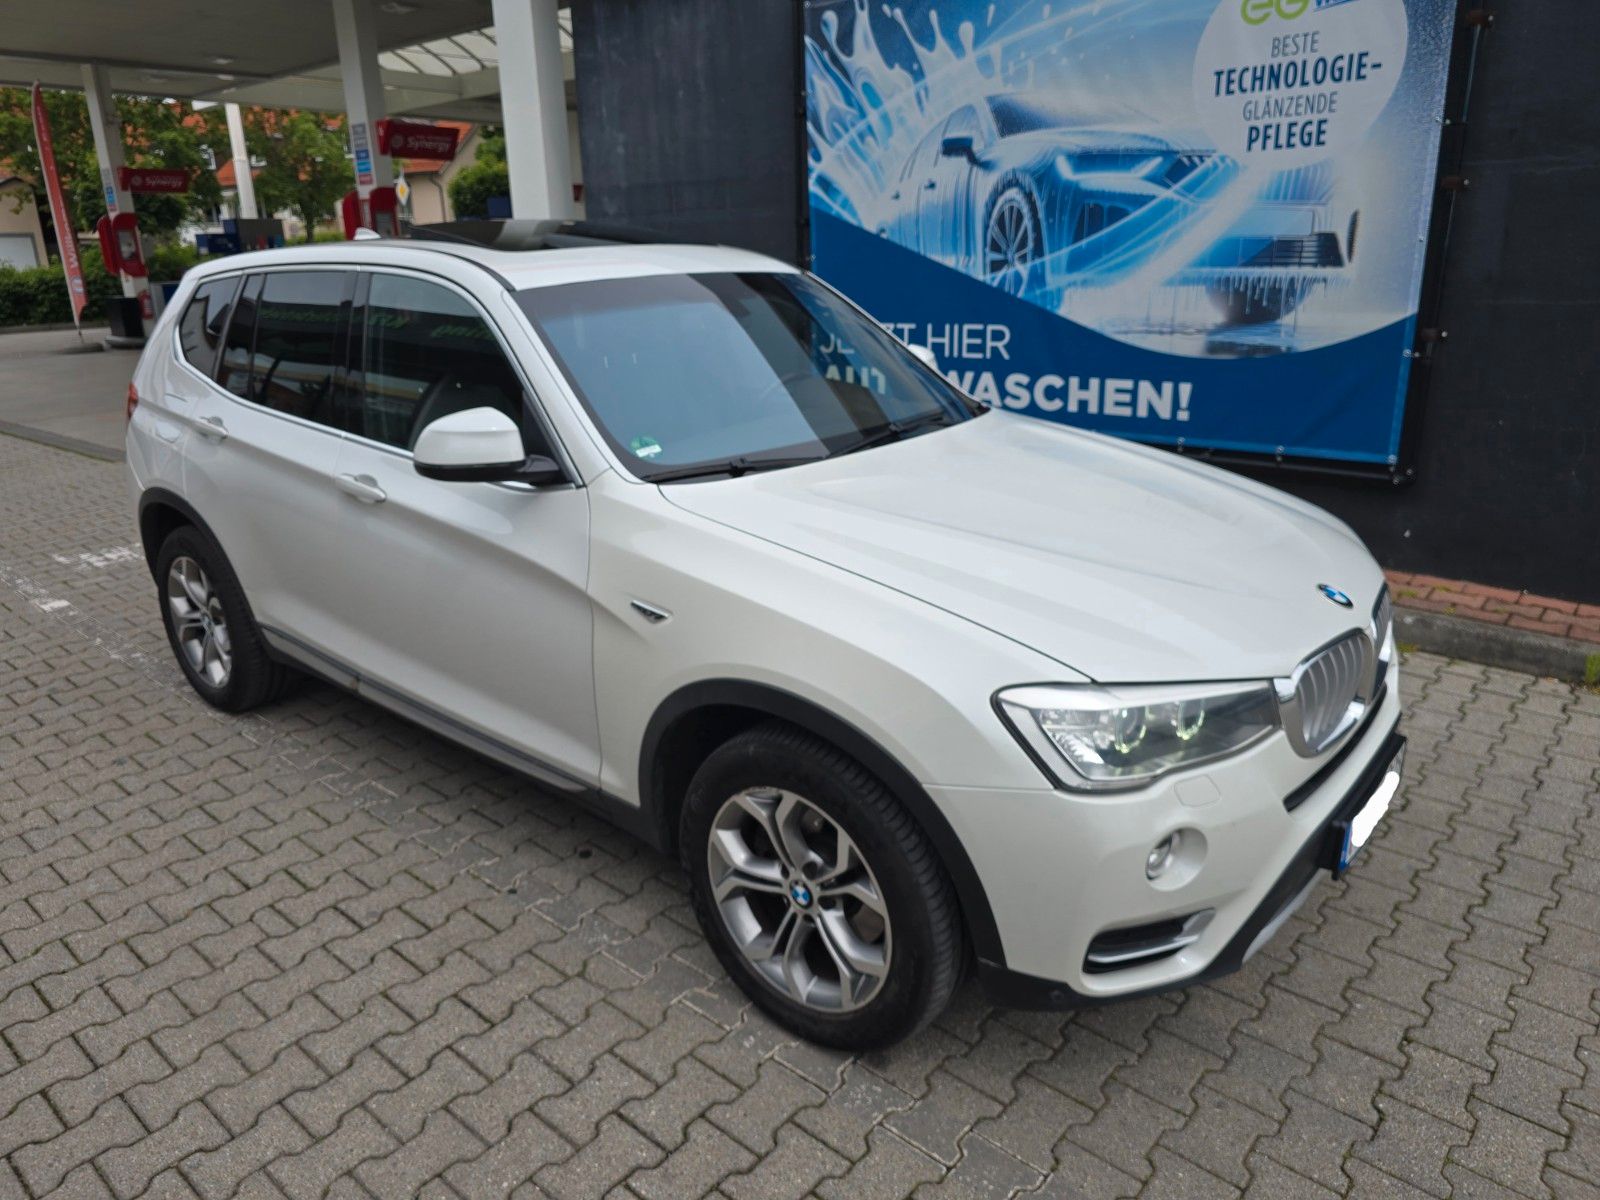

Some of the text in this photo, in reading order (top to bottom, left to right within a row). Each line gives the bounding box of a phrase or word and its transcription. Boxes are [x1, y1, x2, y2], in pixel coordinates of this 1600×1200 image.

[1271, 30, 1320, 58] BESTE
[1213, 51, 1382, 97] TECHNOLOGIE-
[1242, 91, 1338, 122] GLÄNZENDE
[1247, 119, 1328, 152] PFLEGE
[926, 323, 1011, 360] HIER
